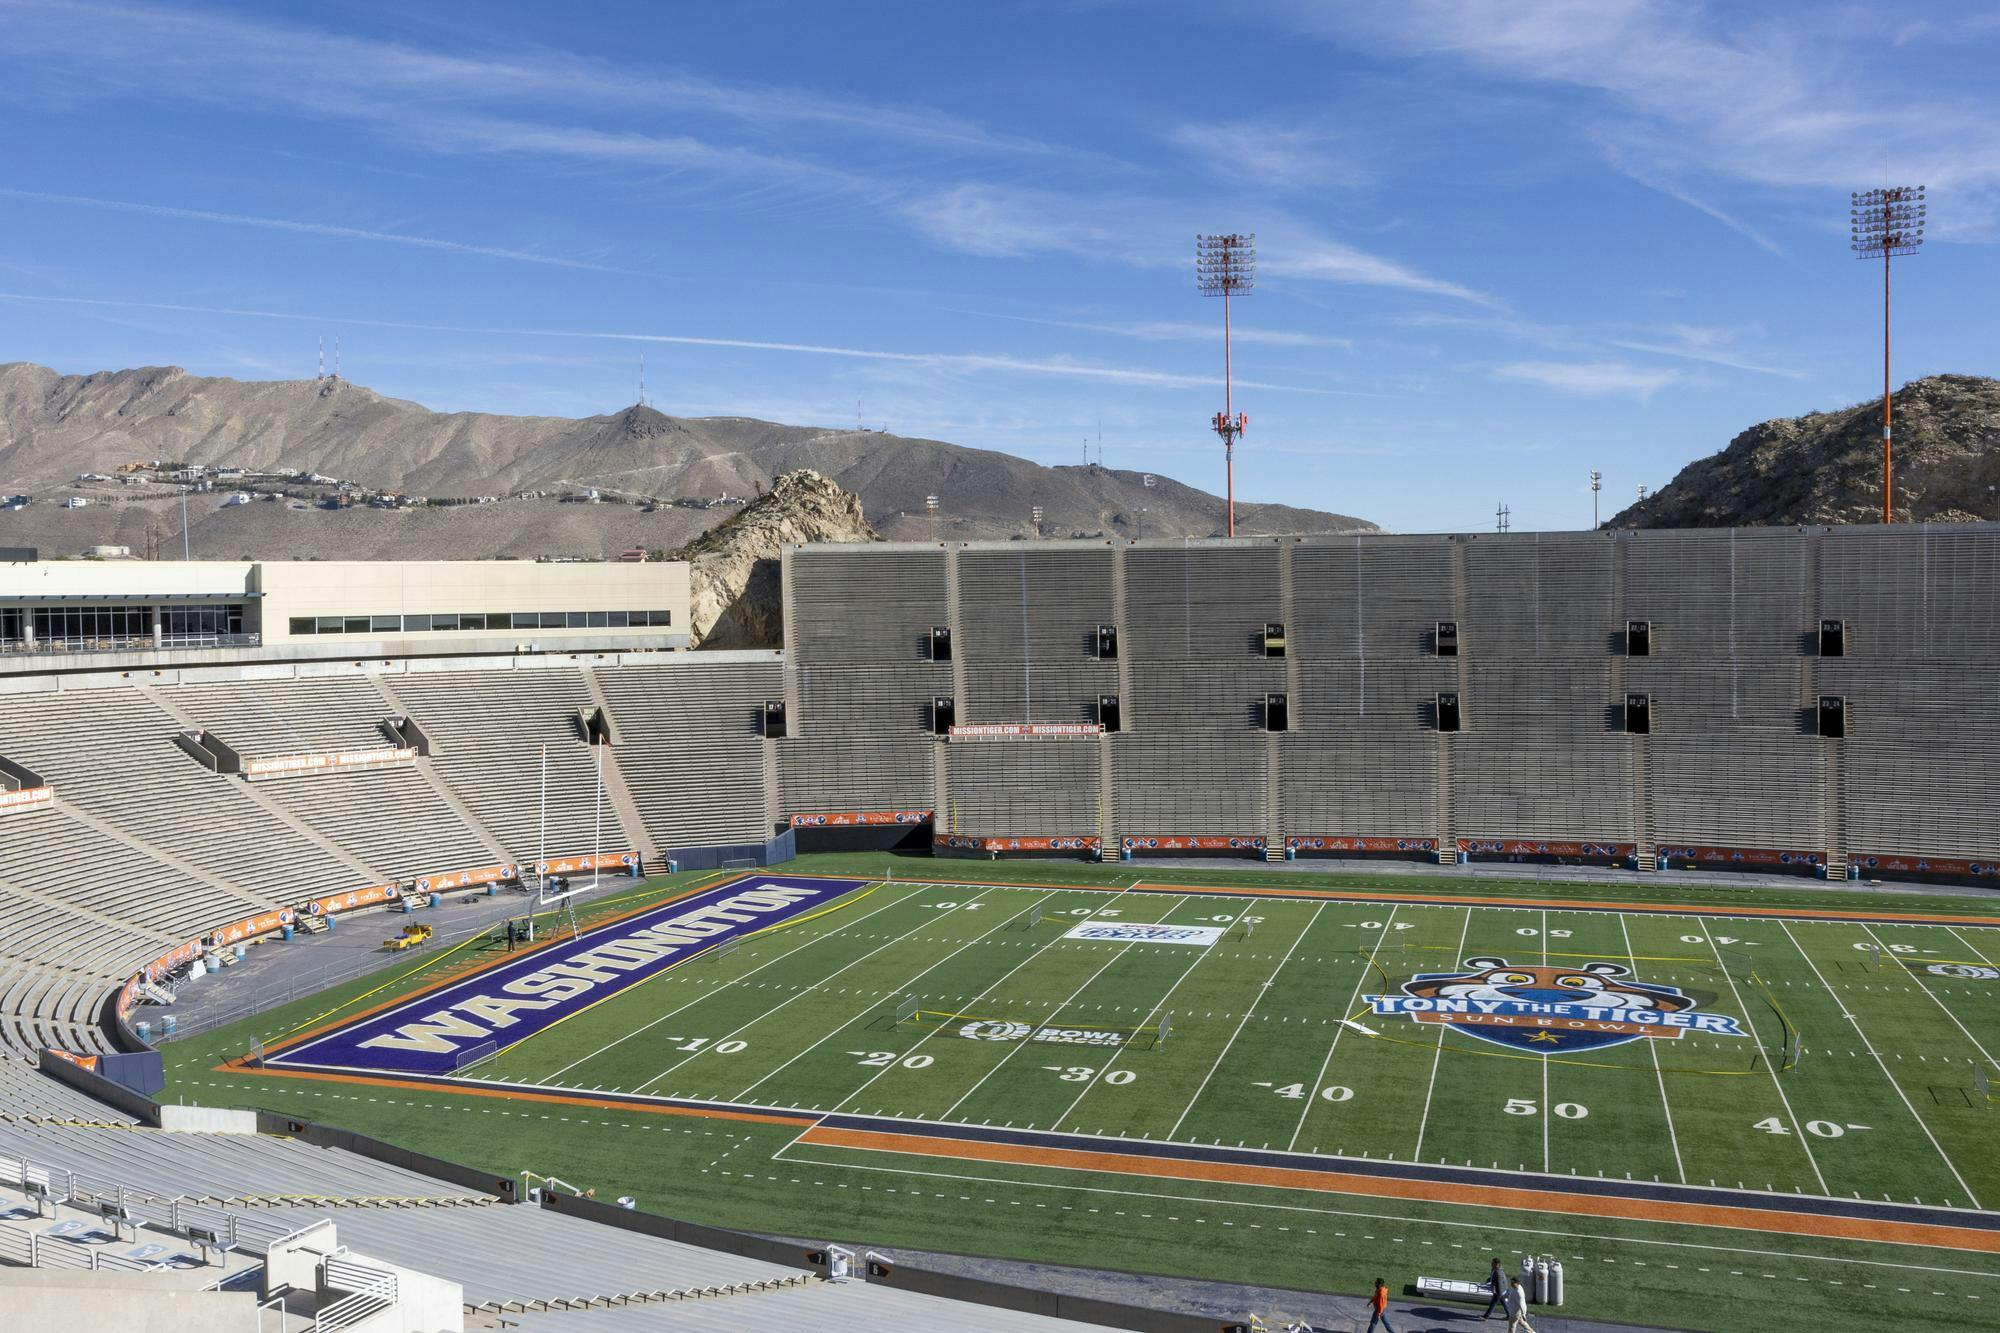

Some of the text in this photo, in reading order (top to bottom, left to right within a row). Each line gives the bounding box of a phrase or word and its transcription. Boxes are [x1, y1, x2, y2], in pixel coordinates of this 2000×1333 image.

[953, 725, 1099, 735] MISSIONTIGER.COM MISSIONTIGER.COM
[357, 882, 822, 1054] WASHINGTON
[1374, 998, 1734, 1033] TONY THE TIGER
[1440, 1013, 1653, 1033] SUN BOWL
[1036, 1028, 1123, 1041] BOWL
